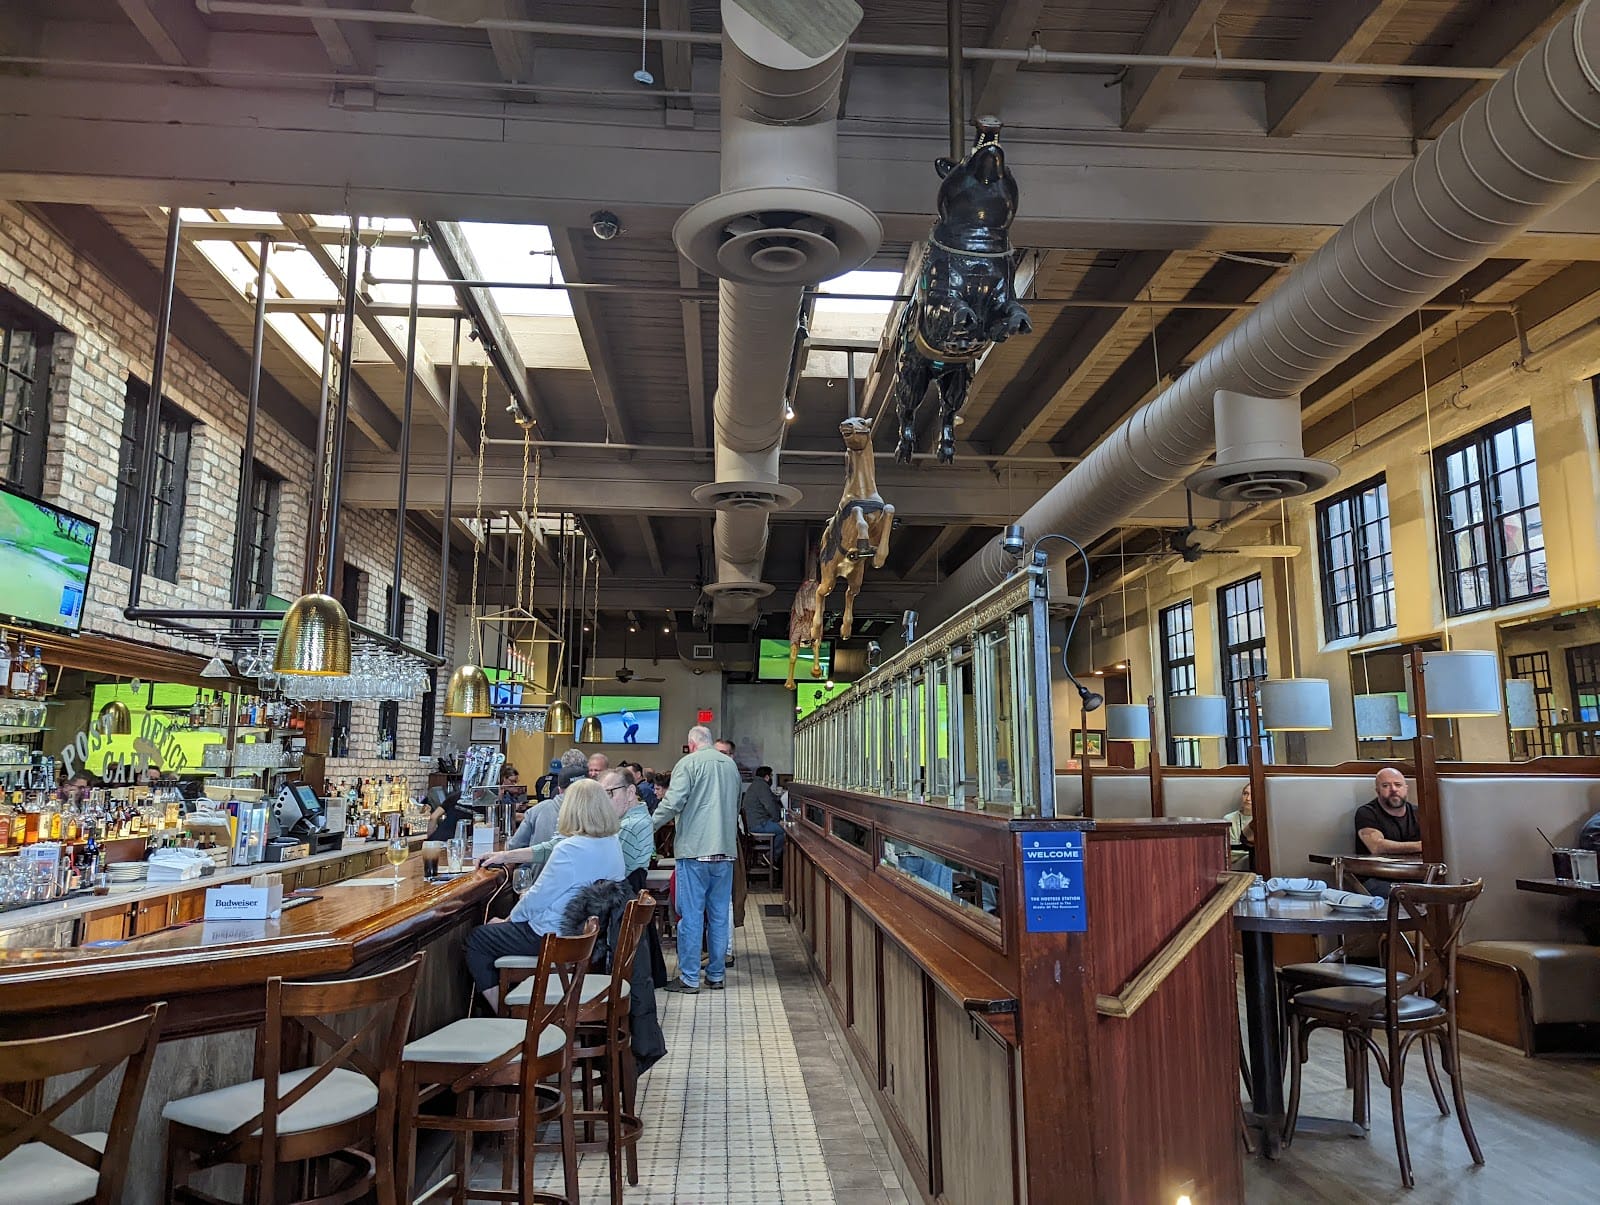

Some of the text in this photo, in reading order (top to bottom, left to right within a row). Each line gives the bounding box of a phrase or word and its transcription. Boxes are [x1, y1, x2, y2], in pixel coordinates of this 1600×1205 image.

[61, 713, 113, 780] POST
[140, 711, 188, 782] OFFICE
[1027, 850, 1079, 858] WELCOME
[215, 899, 258, 907] Budweiser
